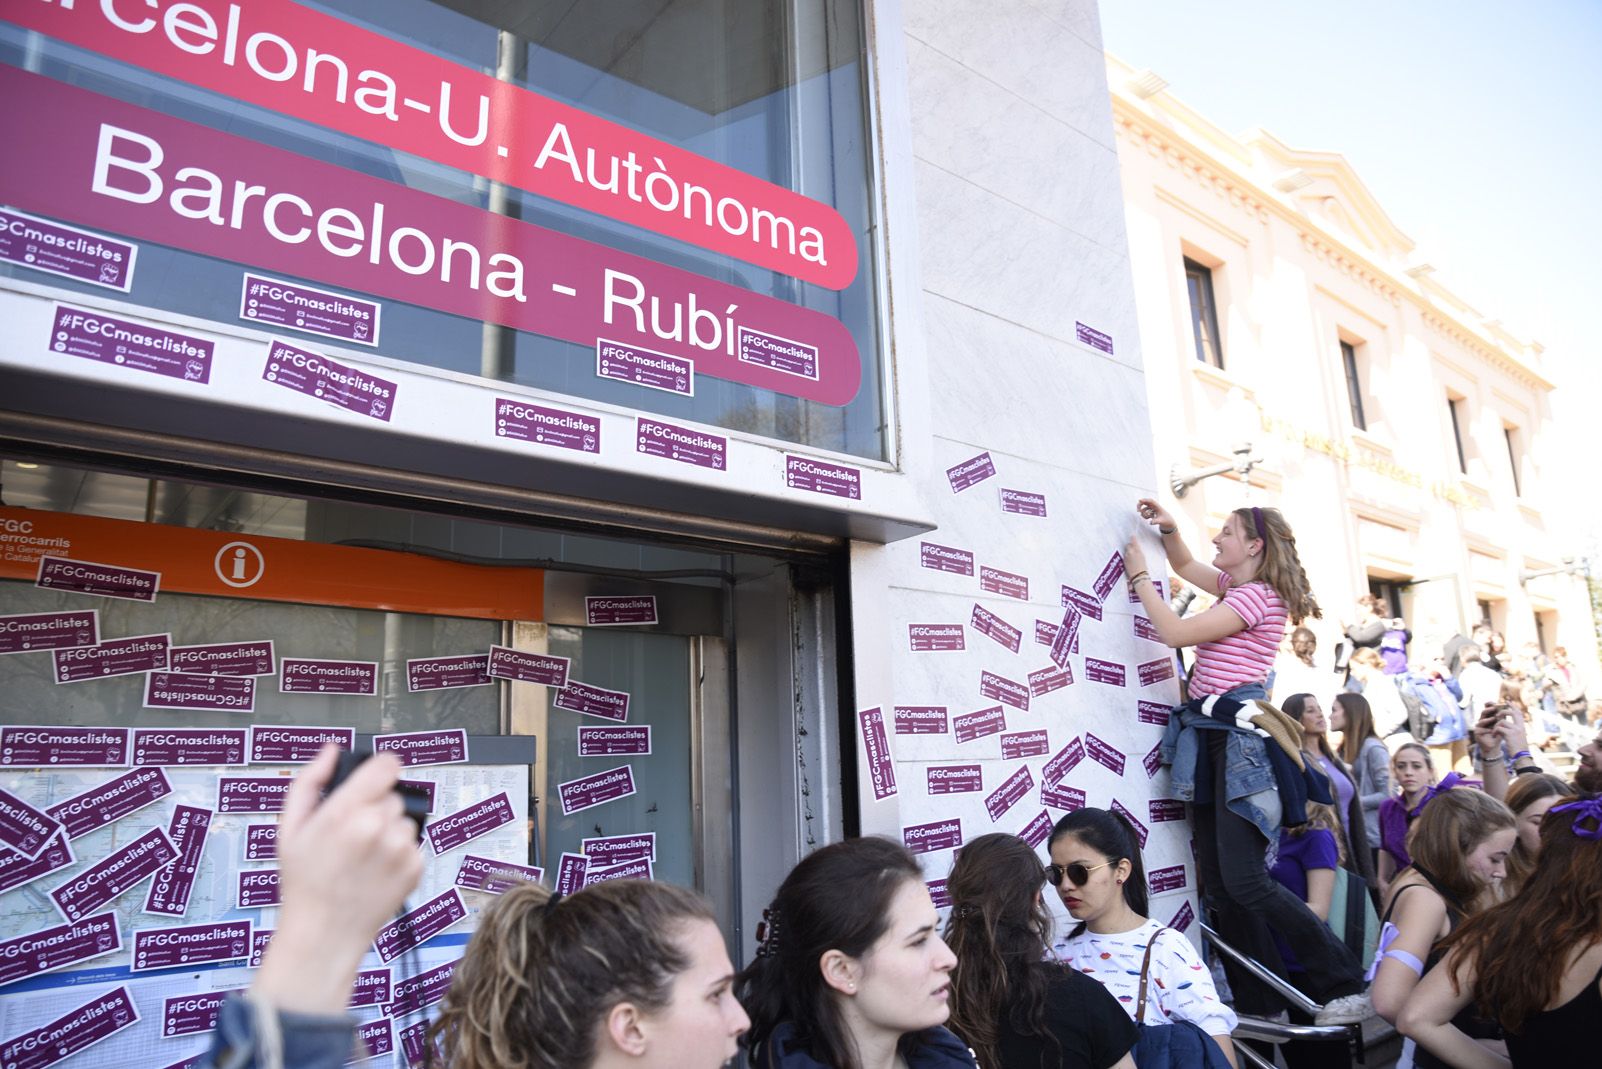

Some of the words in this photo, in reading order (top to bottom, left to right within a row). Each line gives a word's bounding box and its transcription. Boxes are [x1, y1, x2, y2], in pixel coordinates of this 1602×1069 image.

[44, 0, 508, 158] celona-U.
[534, 122, 827, 267] Autònoma
[92, 123, 527, 302] Barcelona
[552, 283, 577, 296] -
[603, 268, 739, 356] Rubí
[250, 283, 370, 320] #FGCmasclistes
[59, 313, 206, 359] #FGCmasclistes
[742, 334, 813, 361] #FGCmasclistes
[273, 348, 390, 398] #FGCmasclistes
[602, 346, 687, 375] #FGCmasclistes
[498, 404, 596, 433] #FGCmasclistes
[639, 423, 723, 452] #FGCmasclistes
[787, 460, 858, 483] #FGCmasclistes
[0, 532, 71, 548] errocarrils
[45, 563, 151, 589] #FGCmasclistes
[589, 600, 652, 610] #FGCmasclistes
[59, 641, 164, 663] #FGCmasclistes
[173, 648, 267, 663] #FGCmasclistes
[493, 651, 564, 672] #FGCmasclistes
[286, 664, 371, 677] #FGCmasclistes
[410, 659, 487, 675] #FGCmasclistes
[154, 690, 250, 706] #FGCmasclistes
[5, 732, 122, 745] #FGCmasclistes
[137, 734, 240, 746] #FGCmasclistes
[255, 731, 348, 745] #FGCmasclistes
[378, 735, 461, 751] #FGCmasclistes
[582, 730, 646, 740] #FGCmasclistes
[863, 714, 886, 796] #FGCmasclistes
[53, 769, 158, 821] #FGCmasclistes
[563, 771, 628, 797] #FGCmasclistes
[431, 799, 506, 837] #FGCmasclistes
[586, 839, 651, 853] #FGCmasclistes
[60, 836, 162, 904] #FGCmasclistes
[377, 895, 456, 945] #FGCmasclistes
[140, 928, 245, 948] #FGCmasclistes
[3, 996, 124, 1061] #FGCmasclistes
